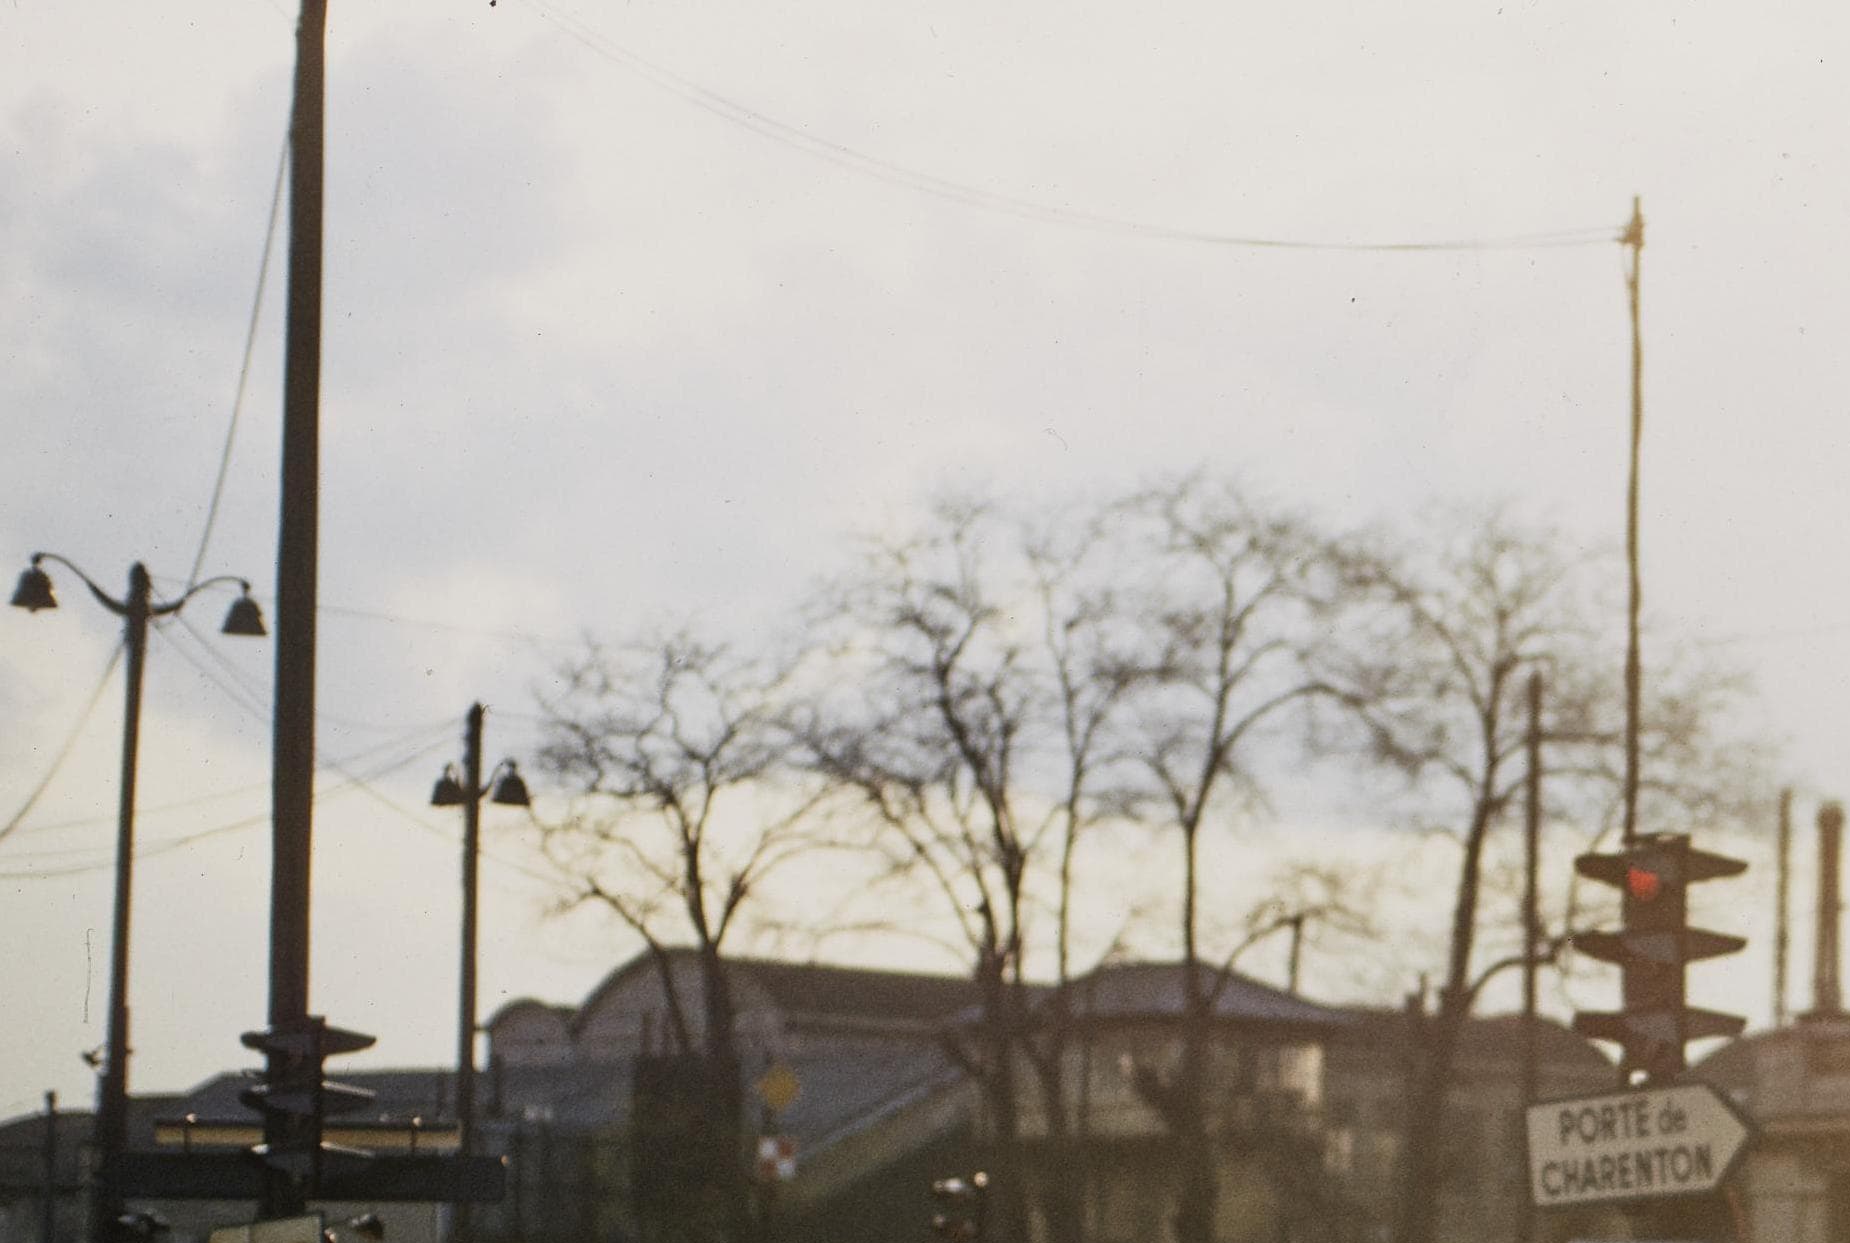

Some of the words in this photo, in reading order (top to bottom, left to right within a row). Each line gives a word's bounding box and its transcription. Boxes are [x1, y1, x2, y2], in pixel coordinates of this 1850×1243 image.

[1558, 1101, 1651, 1145] PORTE
[1658, 1098, 1688, 1135] de
[1541, 1144, 1713, 1196] CHARENTON
